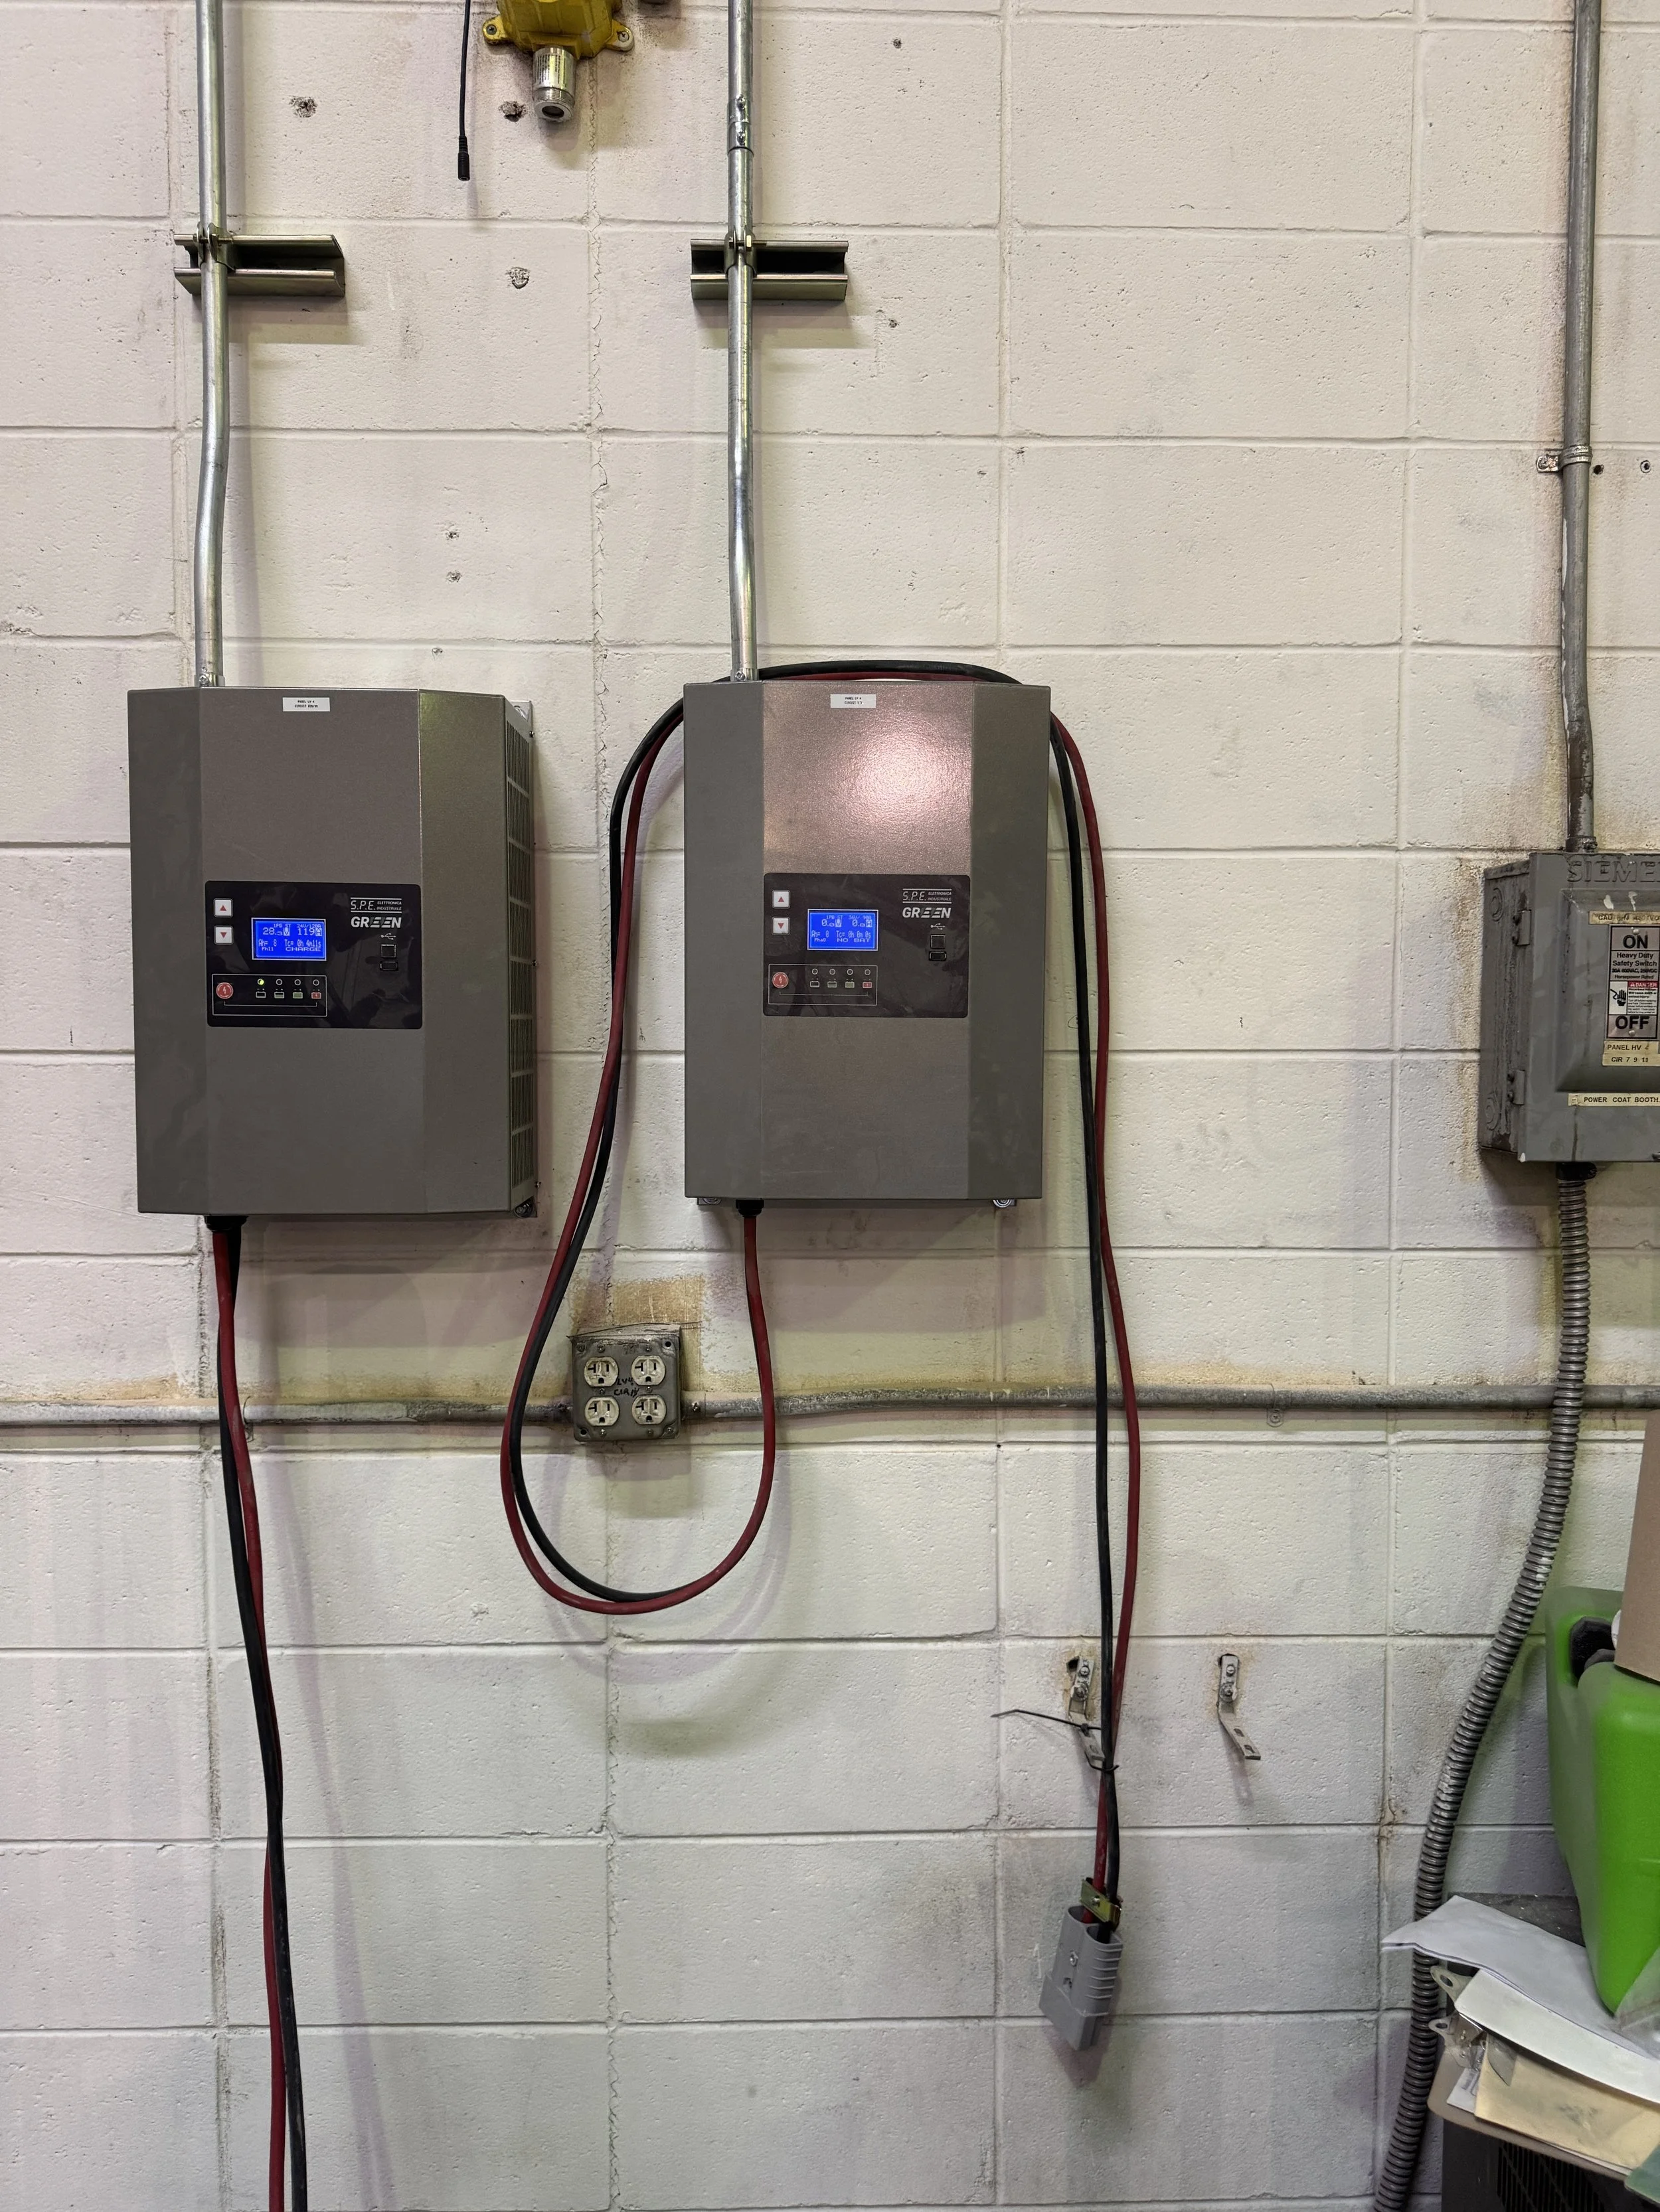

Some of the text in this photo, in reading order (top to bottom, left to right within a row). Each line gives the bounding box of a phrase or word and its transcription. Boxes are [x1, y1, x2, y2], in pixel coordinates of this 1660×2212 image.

[1567, 860, 1660, 882] SIEME
[903, 891, 927, 901] S.P.E.
[351, 900, 376, 910] S.P.E.
[902, 907, 952, 918] GREEN
[351, 916, 402, 928] GREEN
[1623, 935, 1648, 949] ON
[1615, 1016, 1650, 1030] OFF
